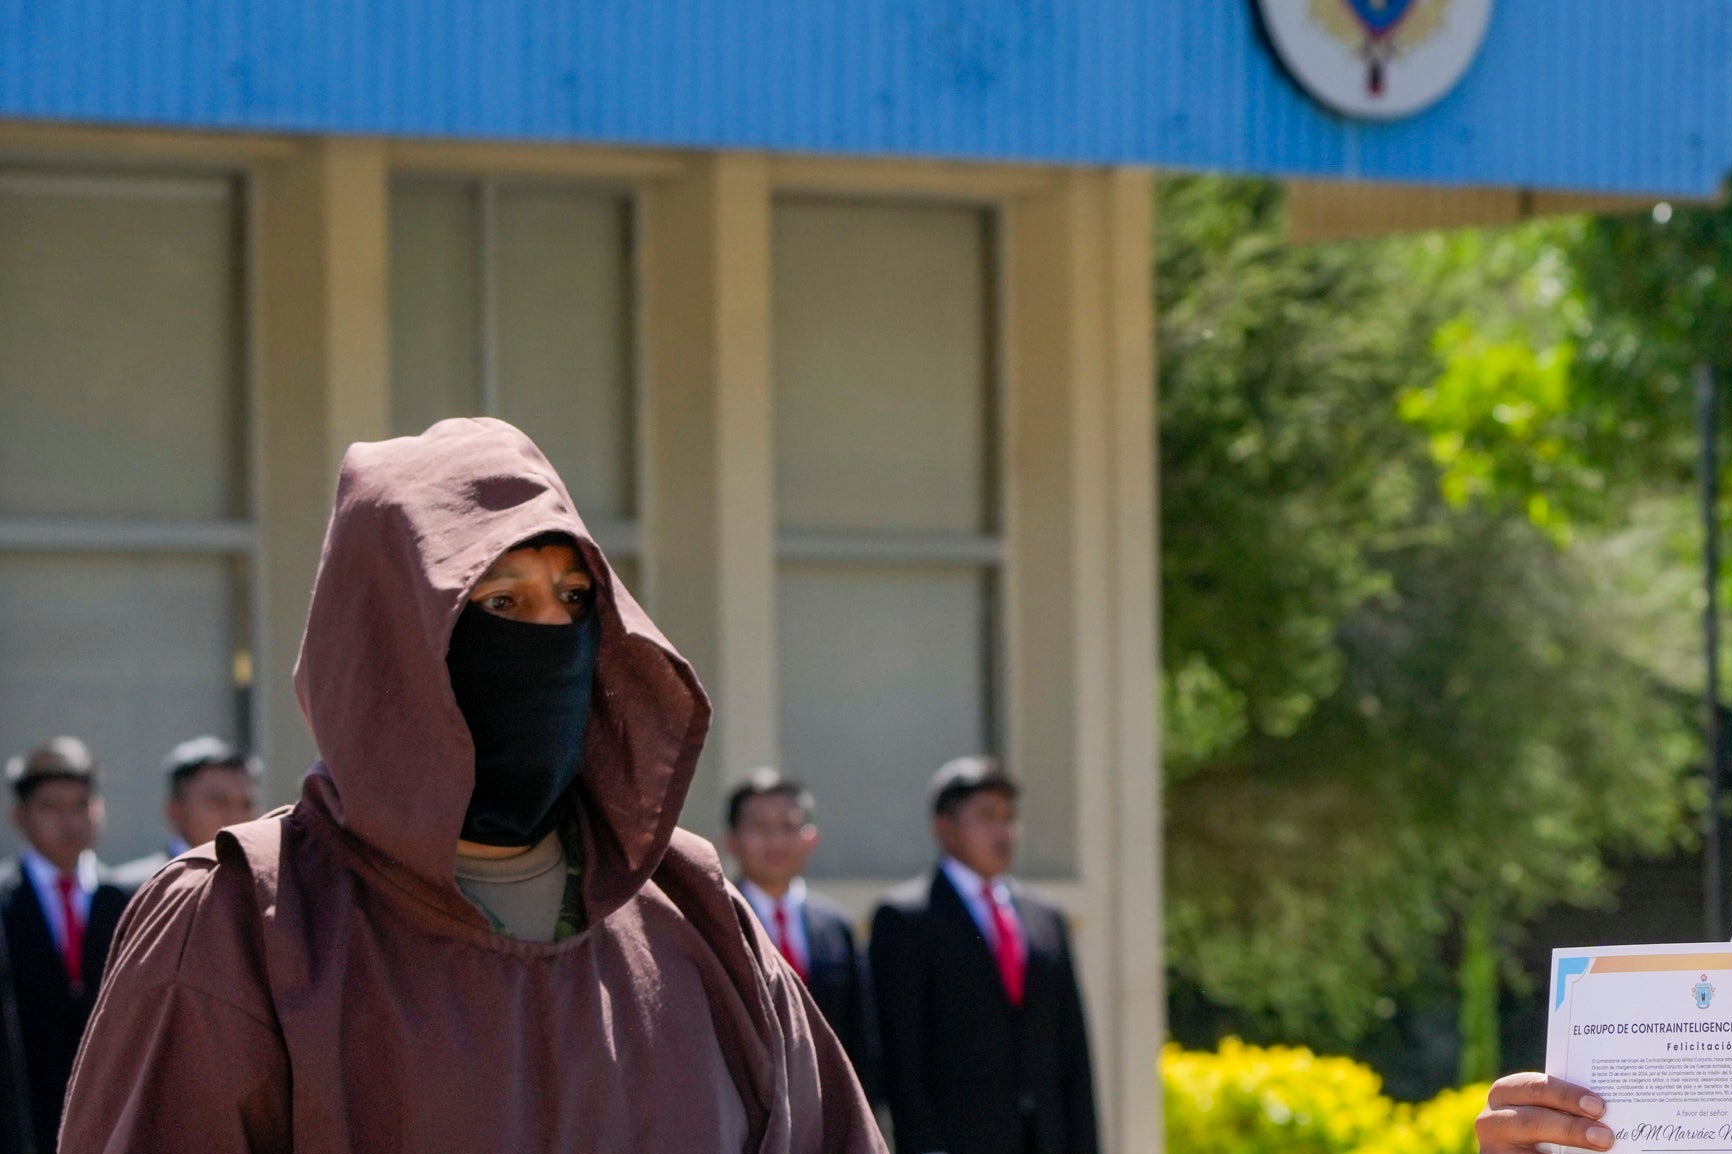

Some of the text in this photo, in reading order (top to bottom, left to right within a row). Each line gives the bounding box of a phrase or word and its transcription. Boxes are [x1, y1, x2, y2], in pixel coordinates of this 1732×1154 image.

[1573, 1025, 1582, 1035] EL
[1584, 1024, 1615, 1035] GRUPO
[1617, 1023, 1629, 1034] DE
[1676, 1109, 1681, 1117] A
[1682, 1109, 1697, 1117] favor
[1698, 1109, 1709, 1117] del
[1662, 1124, 1715, 1141] Narváez
